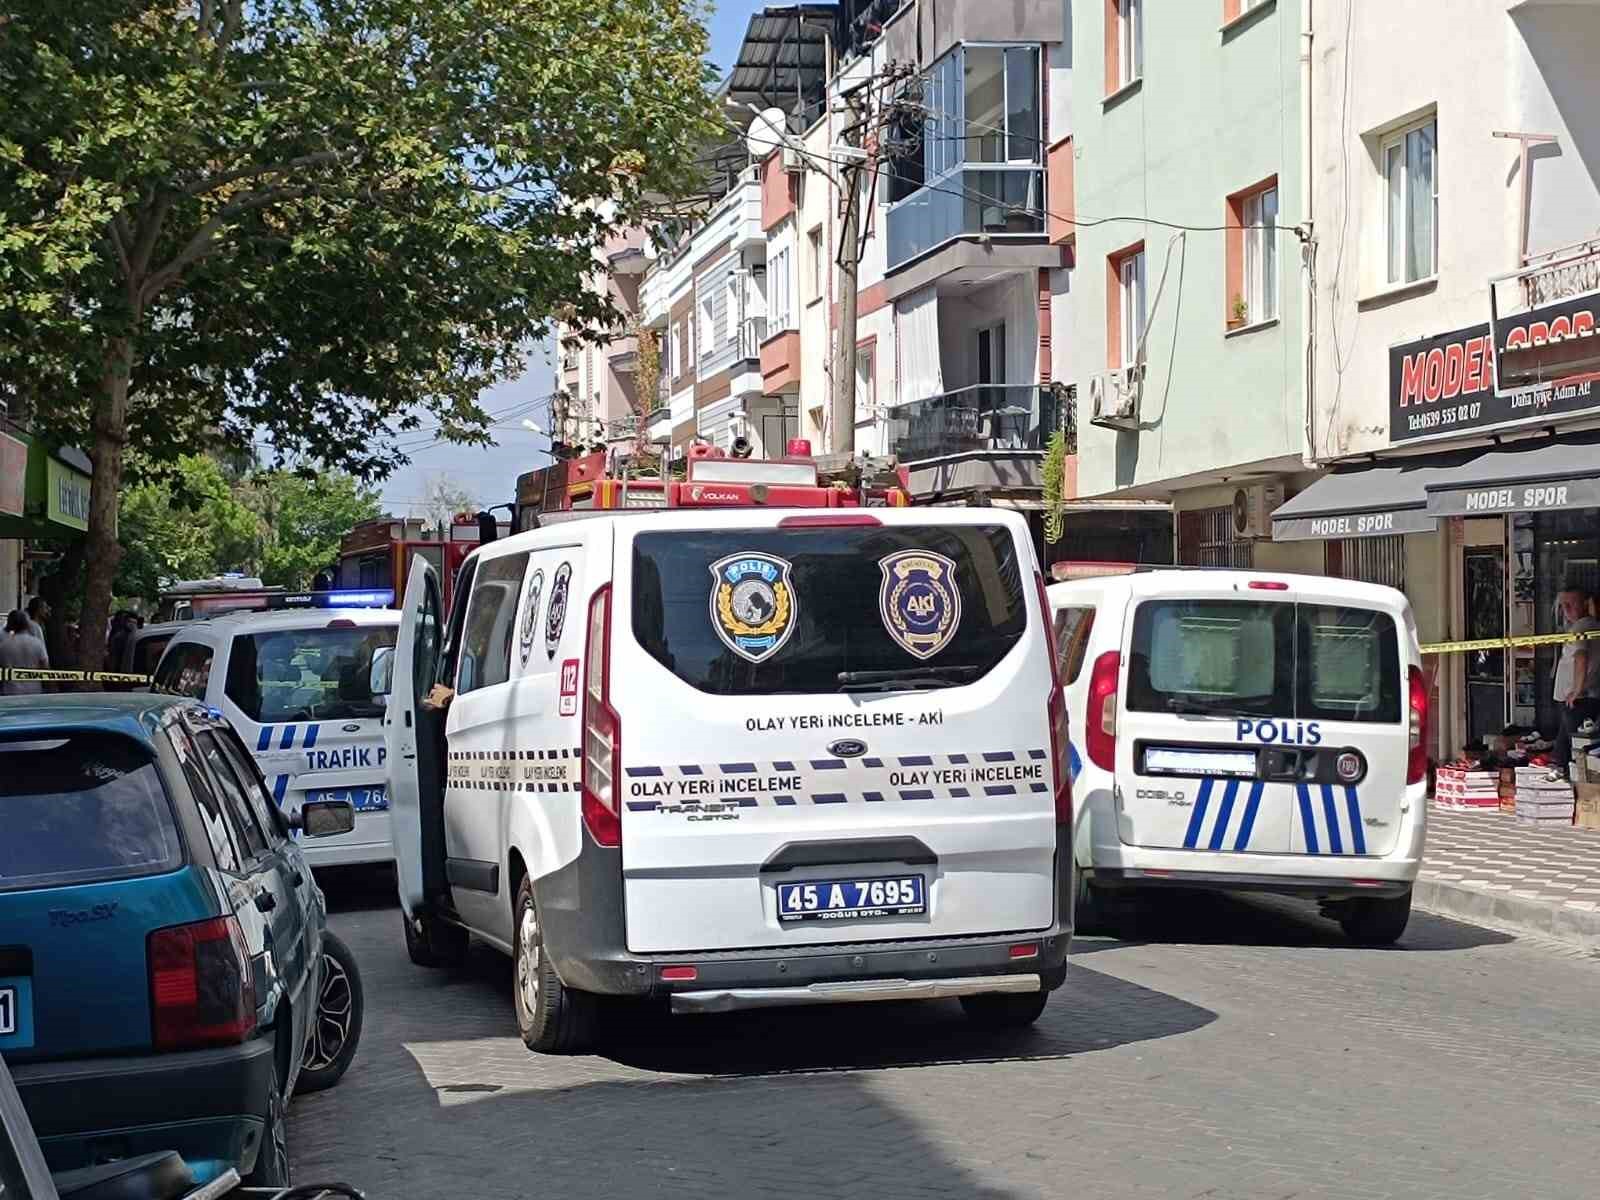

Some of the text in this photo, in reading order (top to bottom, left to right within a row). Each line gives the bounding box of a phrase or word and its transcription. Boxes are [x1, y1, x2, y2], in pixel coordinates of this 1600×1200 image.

[1511, 391, 1532, 408] Daha
[1441, 407, 1457, 424] 555
[1457, 404, 1469, 421] 02
[1470, 402, 1481, 418] 07
[703, 492, 739, 500] VOLKAN
[1465, 486, 1568, 511] MODEL SPOR
[1311, 513, 1393, 535] MODEL SPOR
[563, 664, 576, 692] 112
[746, 717, 785, 731] OLAY
[919, 709, 943, 725] AKİ
[306, 745, 371, 769] TRAFİK
[631, 782, 673, 796] OLAY
[889, 771, 929, 786] OLAY
[788, 879, 915, 910] 45 A 7695
